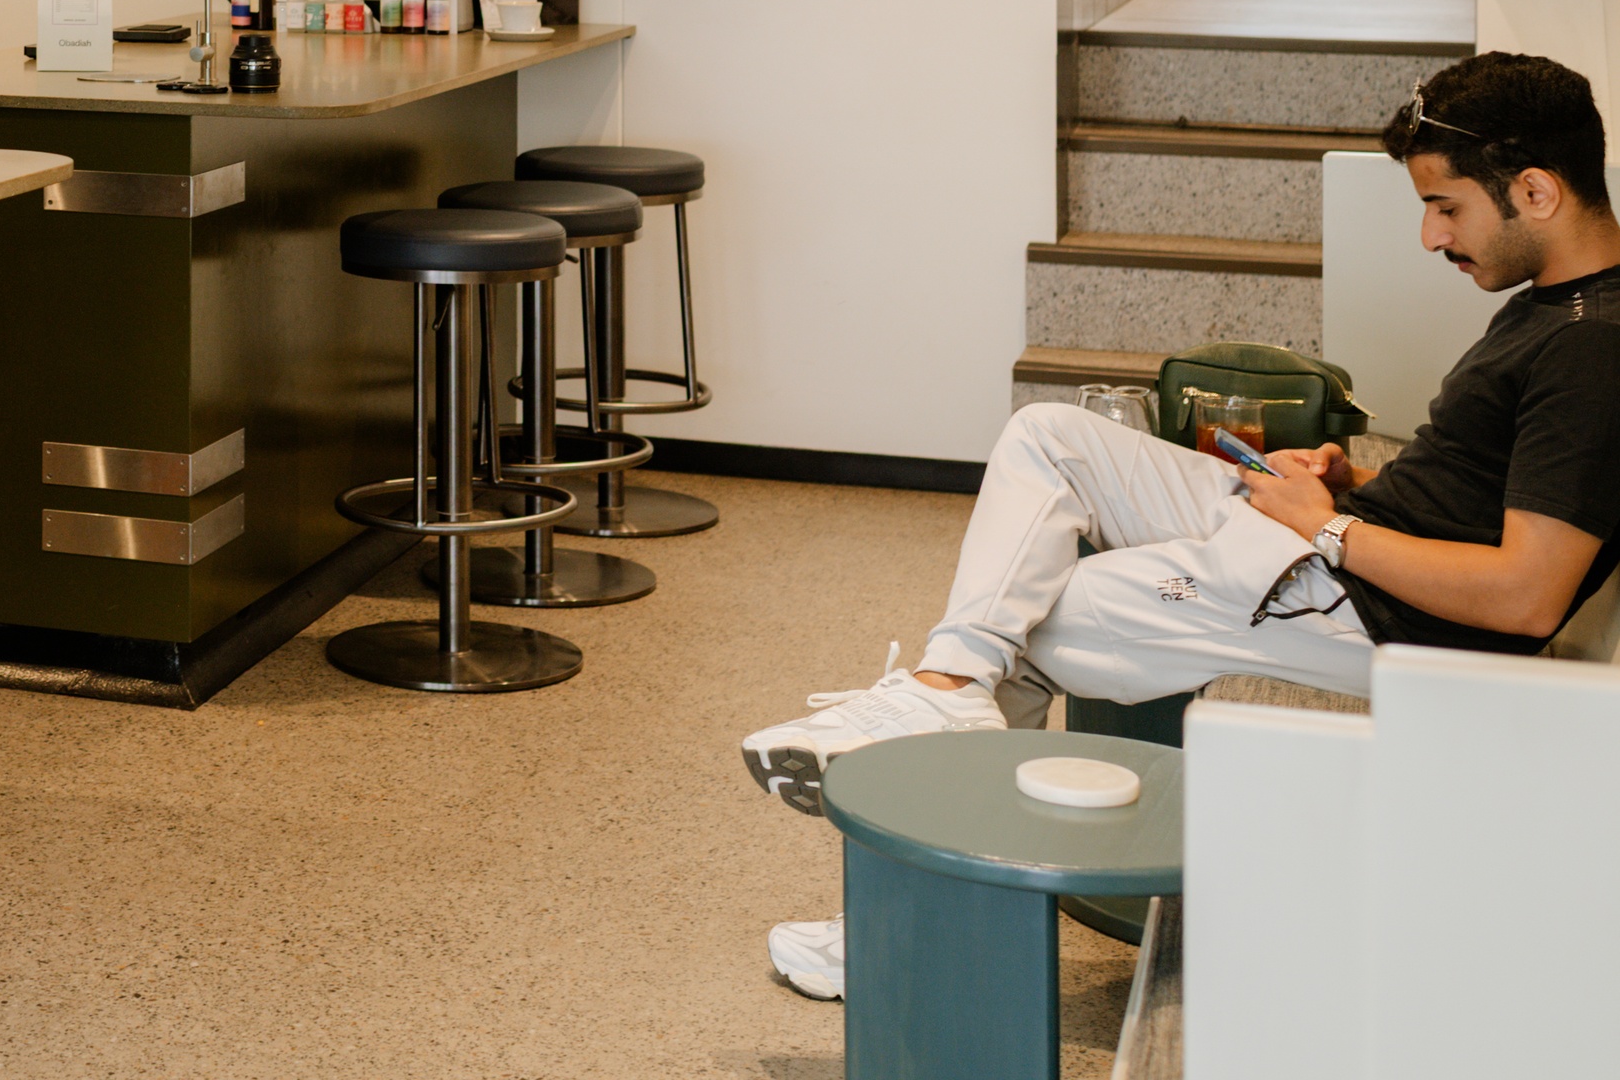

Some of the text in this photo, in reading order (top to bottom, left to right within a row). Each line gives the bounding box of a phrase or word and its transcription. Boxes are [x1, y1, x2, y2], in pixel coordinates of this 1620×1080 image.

[58, 39, 92, 47] Obadiah
[1156, 579, 1173, 602] TIC
[1171, 577, 1184, 601] HEN
[1183, 576, 1198, 599] AUT
